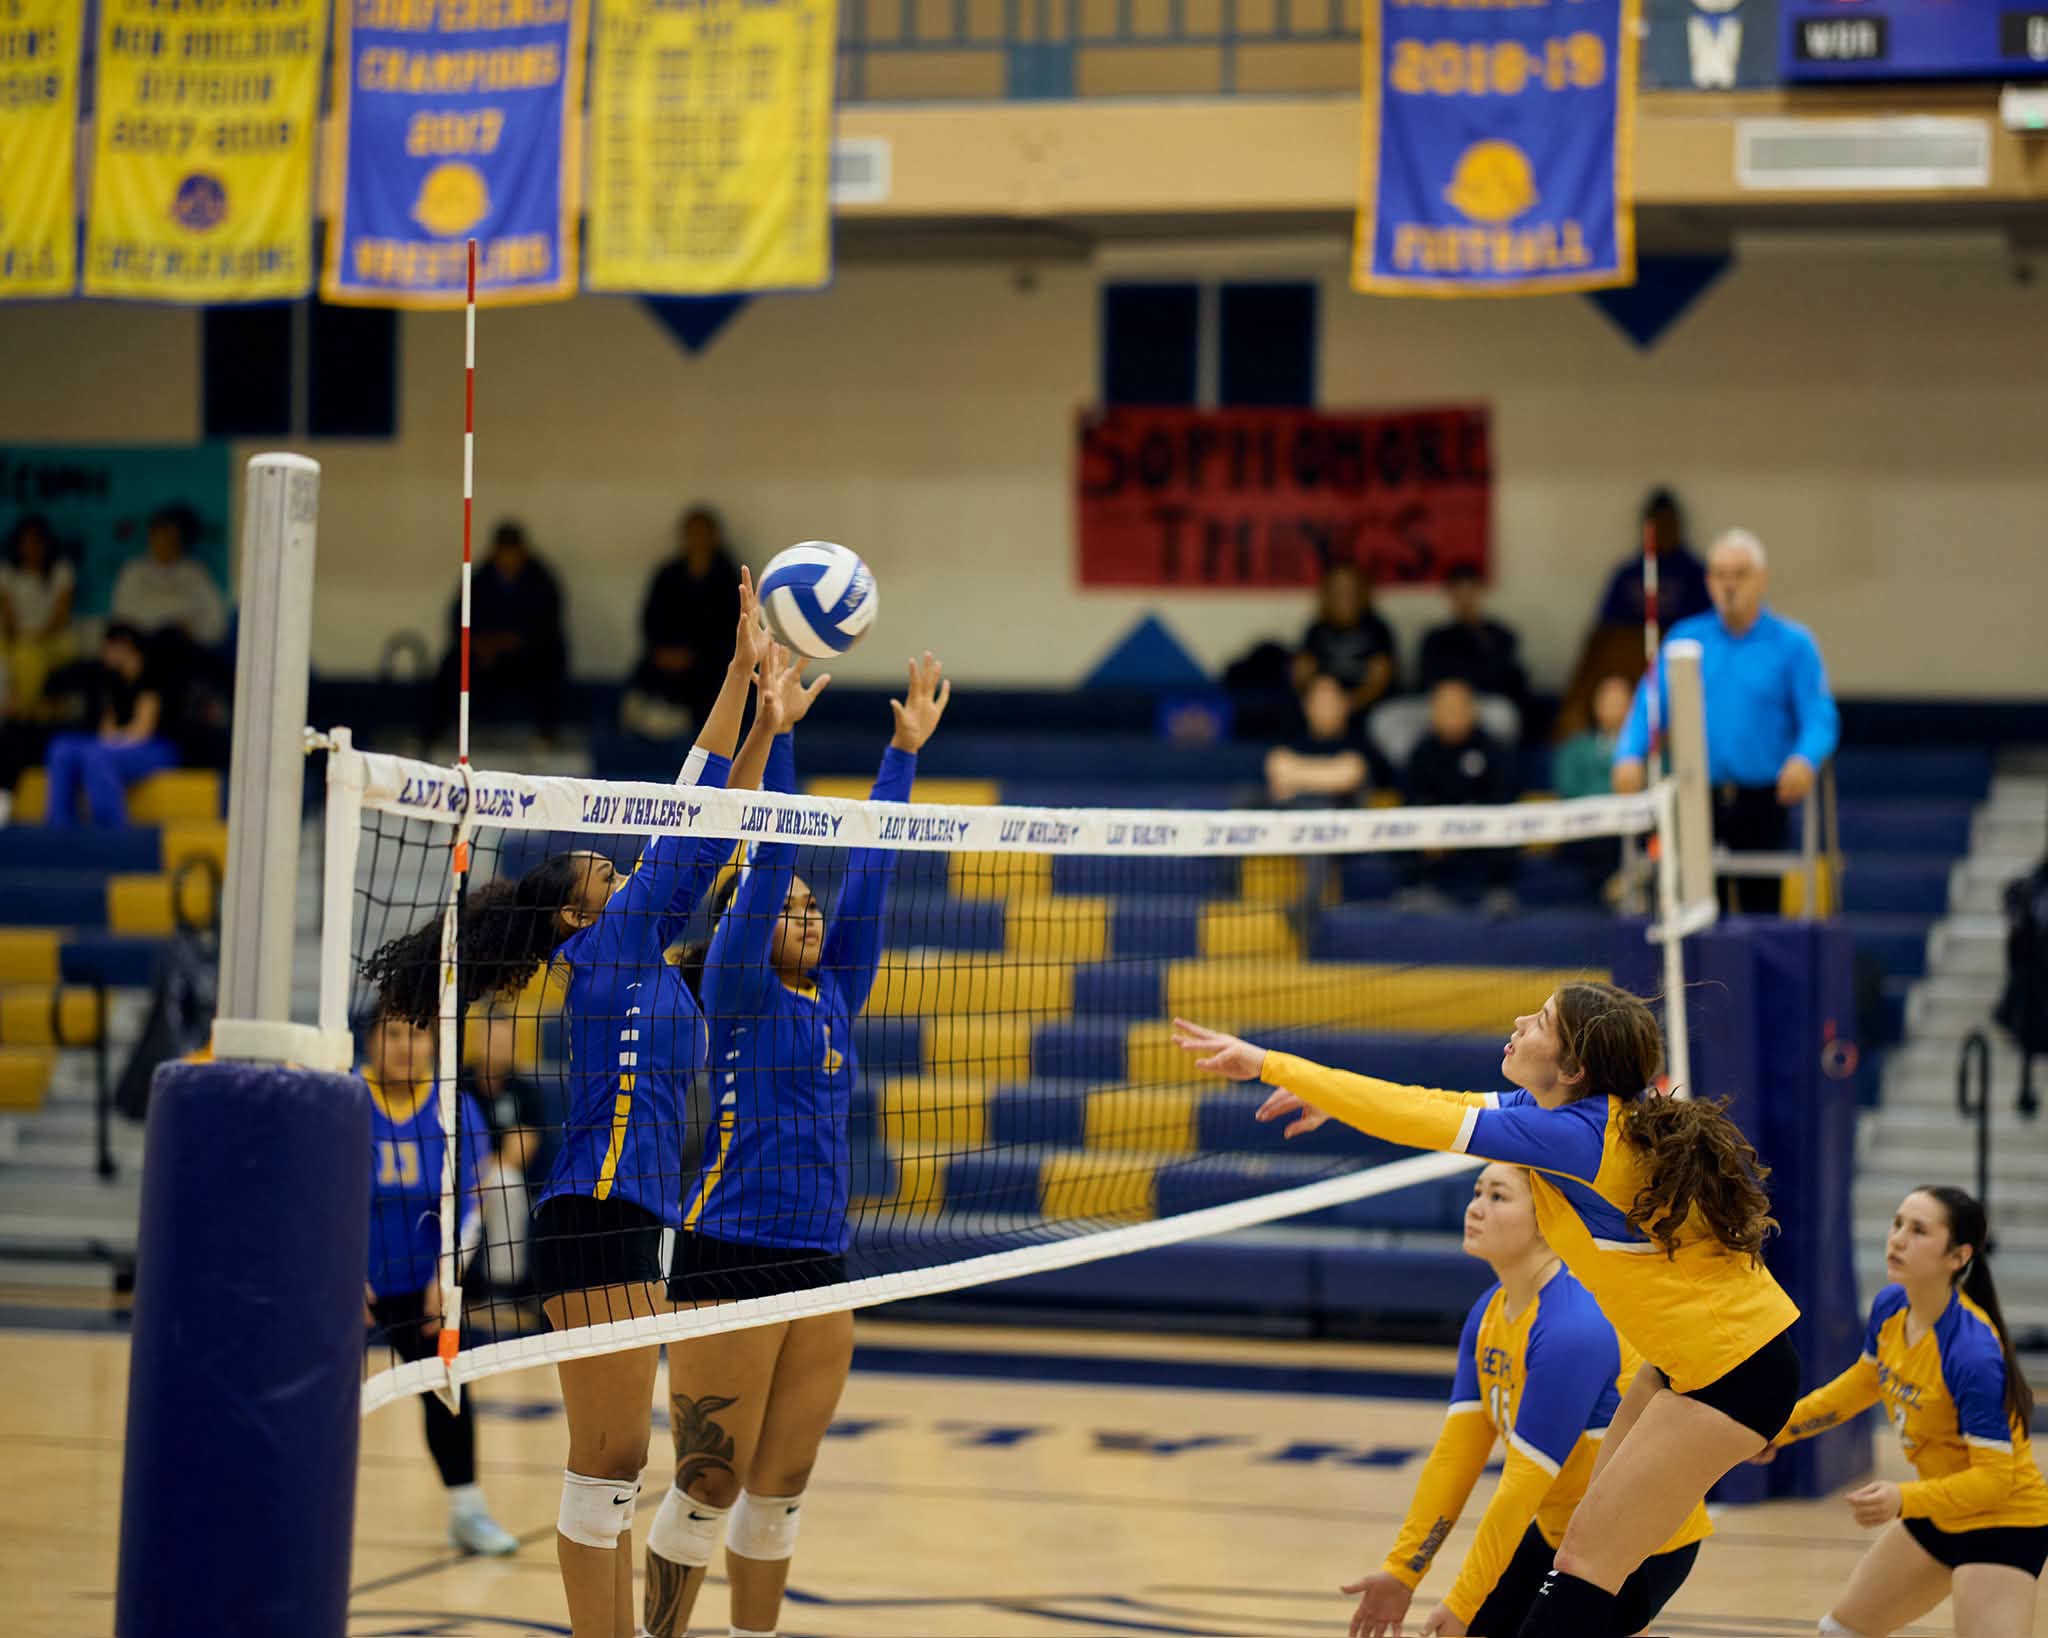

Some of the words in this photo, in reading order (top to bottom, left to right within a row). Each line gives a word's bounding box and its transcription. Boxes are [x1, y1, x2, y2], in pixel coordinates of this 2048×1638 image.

[447, 784, 515, 817] WLERS
[582, 794, 620, 824] LADY
[622, 797, 686, 828] WHALERS
[740, 805, 773, 832] LADY
[775, 807, 829, 837] WHALERS
[879, 815, 906, 841] LADY
